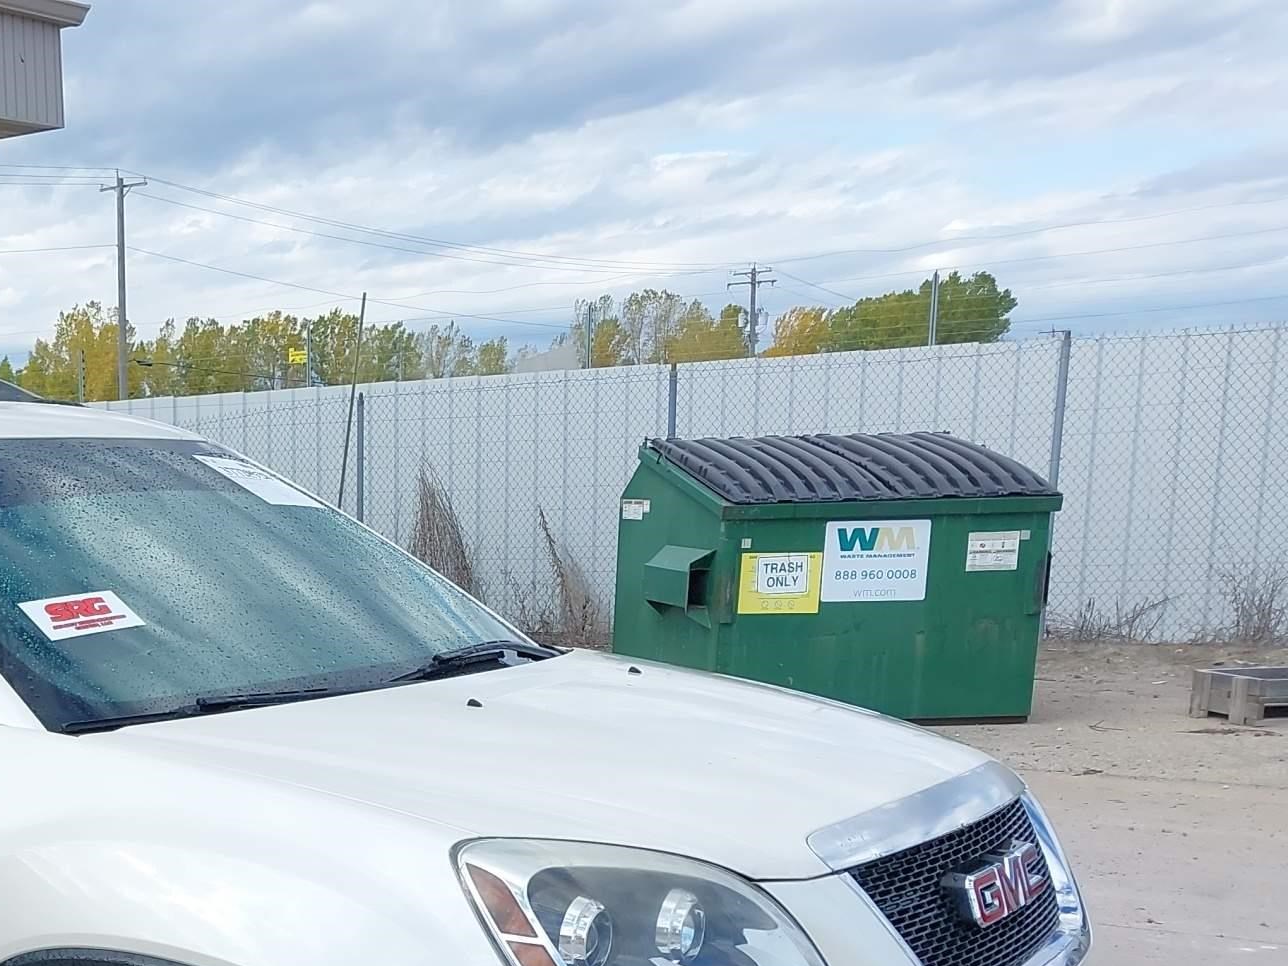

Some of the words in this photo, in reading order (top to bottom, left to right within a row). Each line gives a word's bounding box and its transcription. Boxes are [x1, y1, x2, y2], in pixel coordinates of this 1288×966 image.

[837, 526, 917, 552] WM
[763, 562, 804, 575] TRASH
[834, 569, 858, 581] 888
[860, 569, 884, 580] 960
[886, 568, 917, 580] 0008
[766, 576, 799, 588] ONLY
[853, 588, 897, 598] wm.com
[966, 842, 1047, 929] GMC
